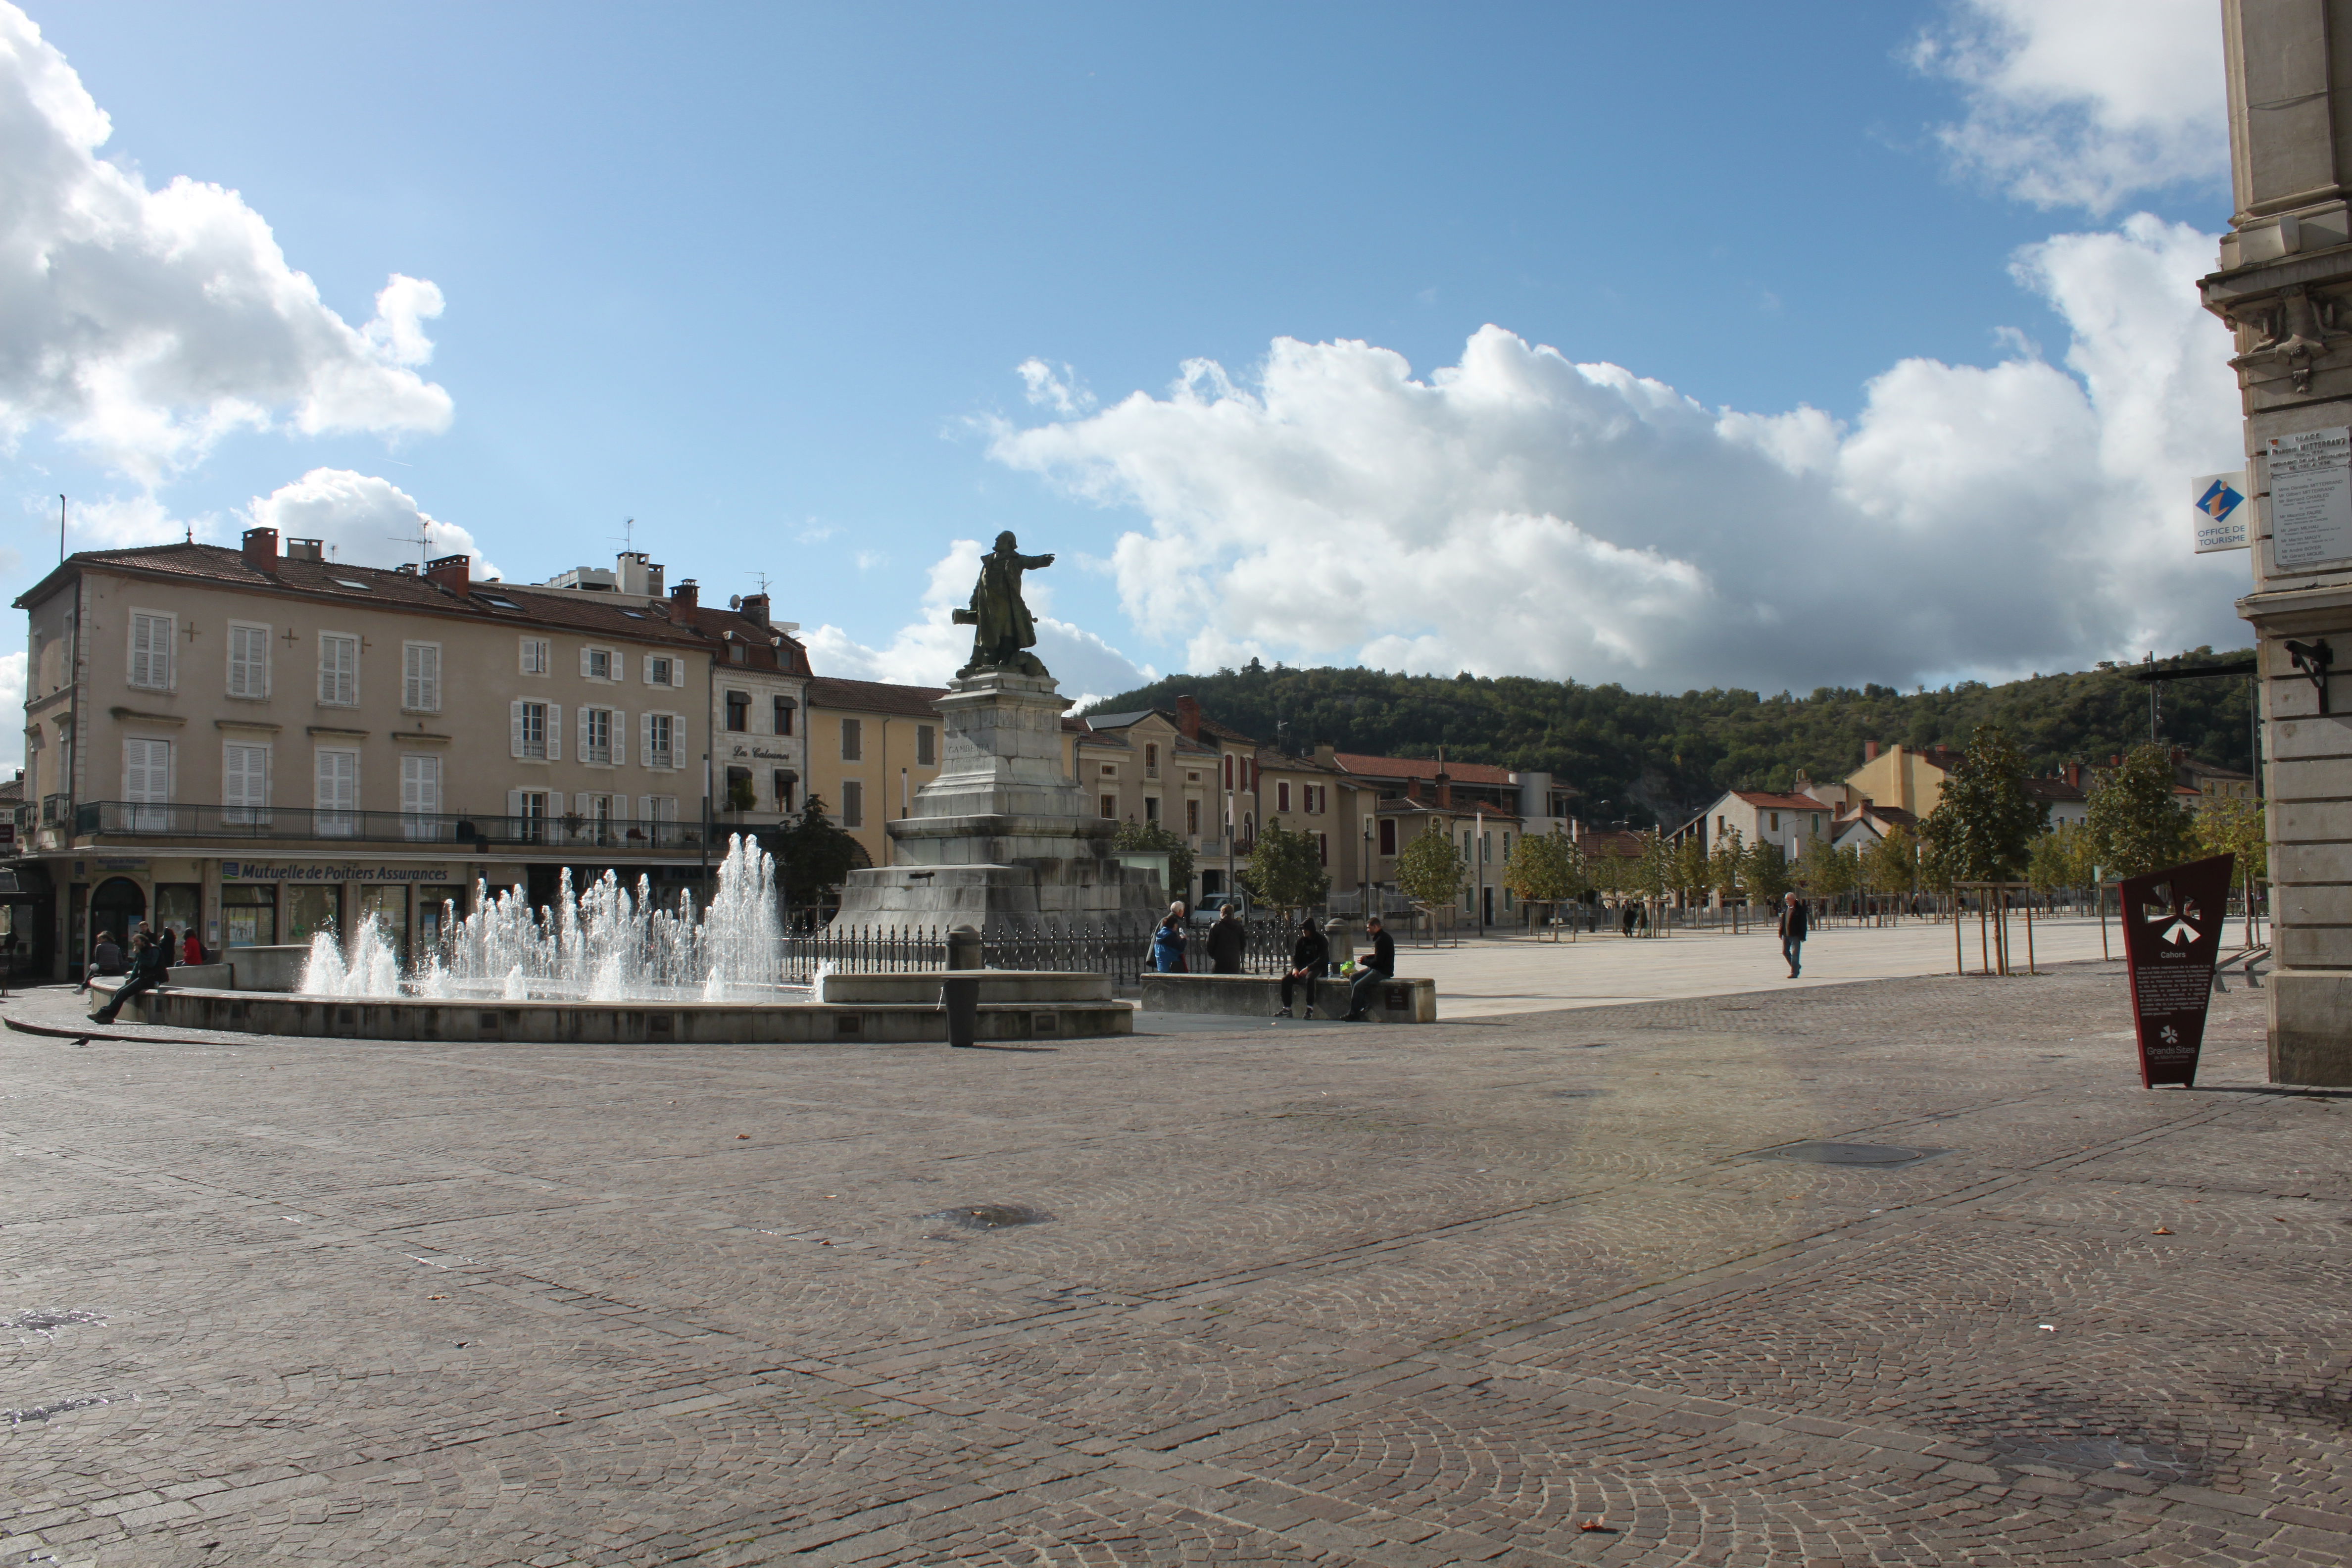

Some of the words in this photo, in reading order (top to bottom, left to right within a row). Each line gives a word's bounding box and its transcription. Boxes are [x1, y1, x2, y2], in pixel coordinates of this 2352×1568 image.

[2294, 433, 2320, 442] PLACE
[2300, 438, 2345, 451] MITTERRAND
[2198, 527, 2230, 537] OFFICE
[2199, 535, 2245, 546] TOURISME
[733, 745, 747, 756] Les
[948, 743, 989, 753] GAMBETTA
[242, 864, 304, 879] Mutuelle
[305, 865, 322, 879] de
[324, 866, 375, 880] Poitiers
[377, 866, 448, 880] Assurances
[2147, 1046, 2175, 1055] Grands
